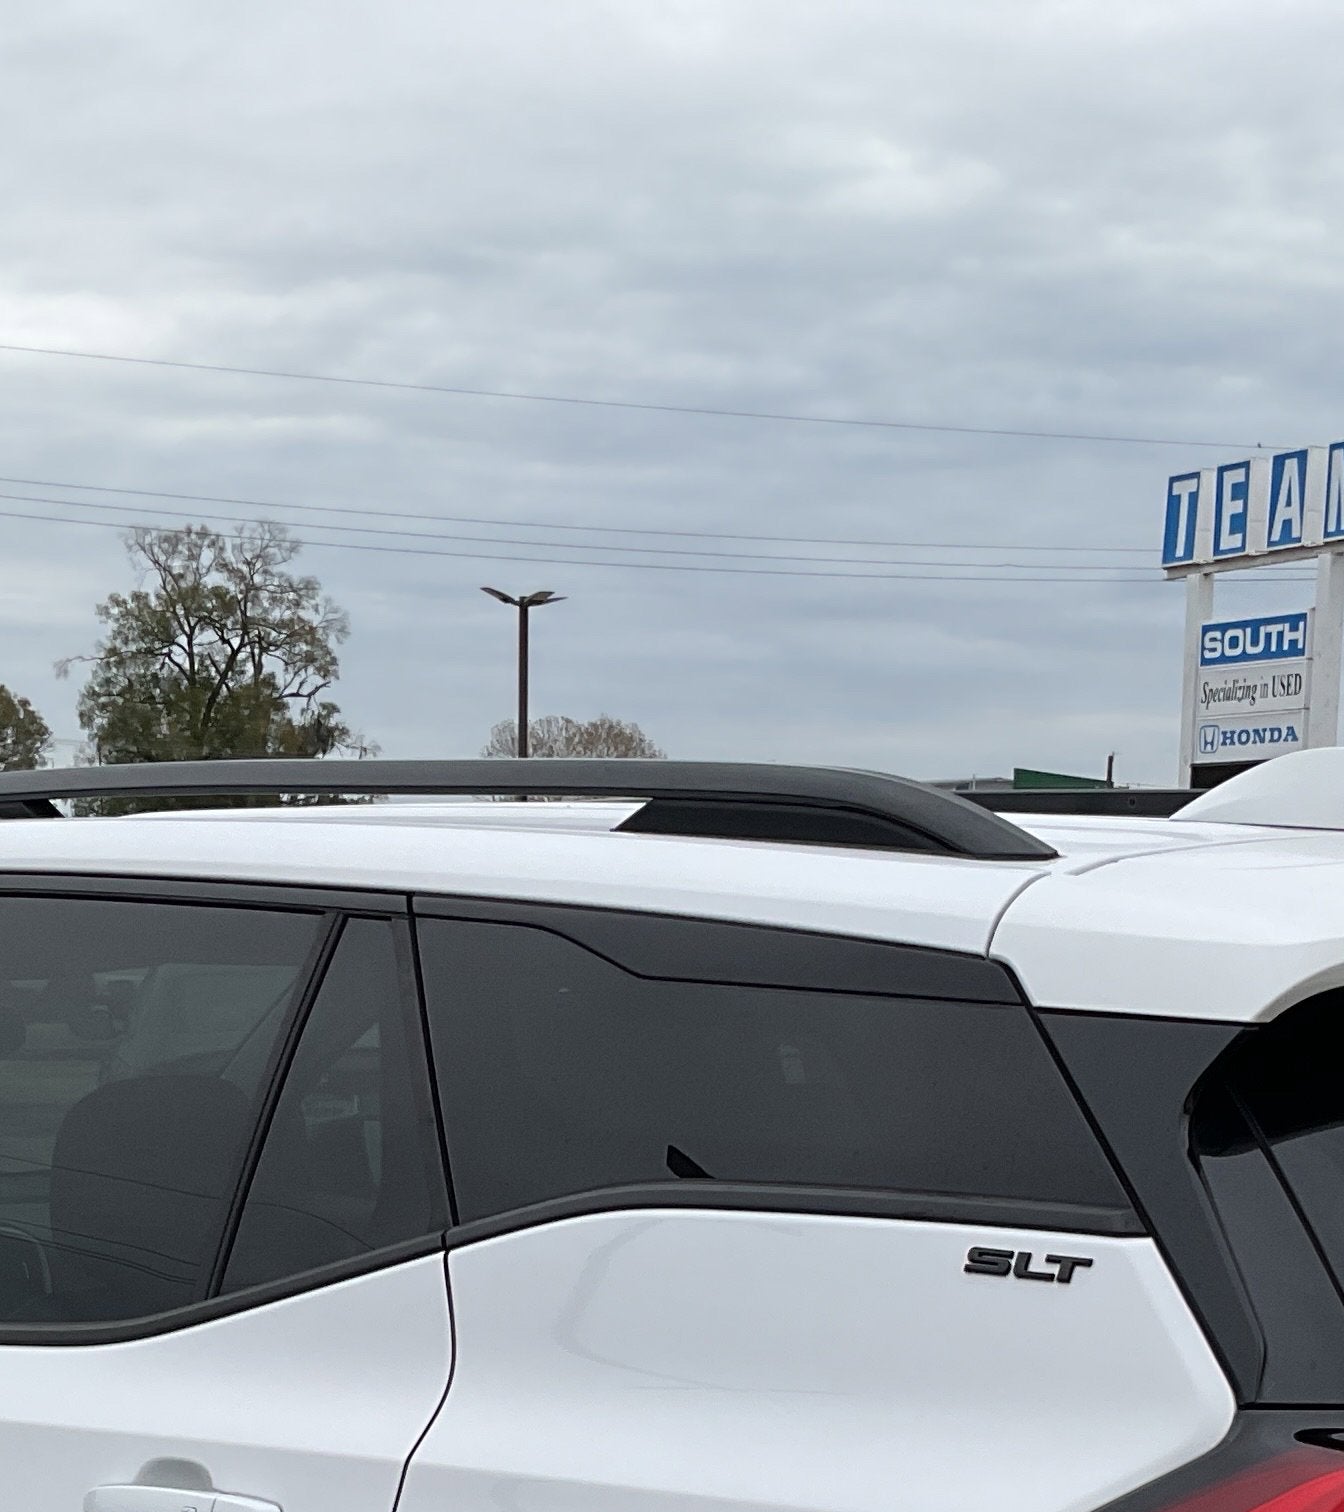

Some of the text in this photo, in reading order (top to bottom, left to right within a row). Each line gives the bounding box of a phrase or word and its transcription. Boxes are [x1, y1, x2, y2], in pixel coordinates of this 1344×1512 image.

[1203, 621, 1305, 660] SOUTH
[1201, 673, 1302, 710] Specializing in USED
[1220, 726, 1299, 747] HONDA
[963, 1245, 1094, 1284] SLT
